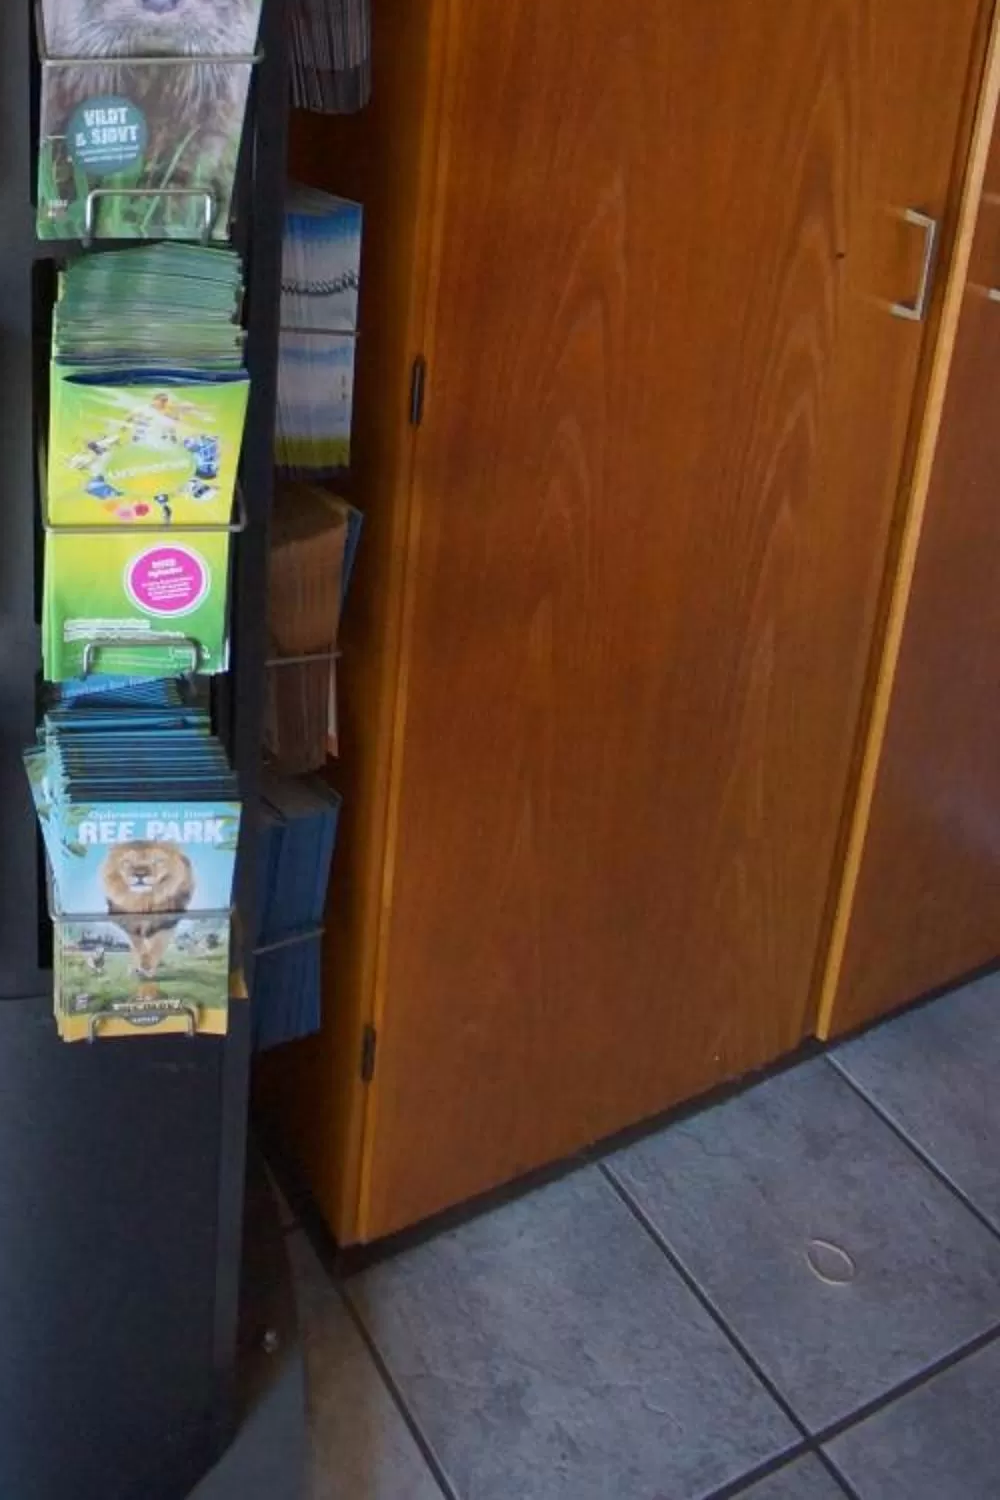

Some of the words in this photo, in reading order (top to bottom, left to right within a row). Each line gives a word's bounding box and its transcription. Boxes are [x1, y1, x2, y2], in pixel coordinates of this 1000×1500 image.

[84, 107, 128, 128] VILDT
[78, 819, 136, 845] REE
[146, 818, 226, 844] PARK
